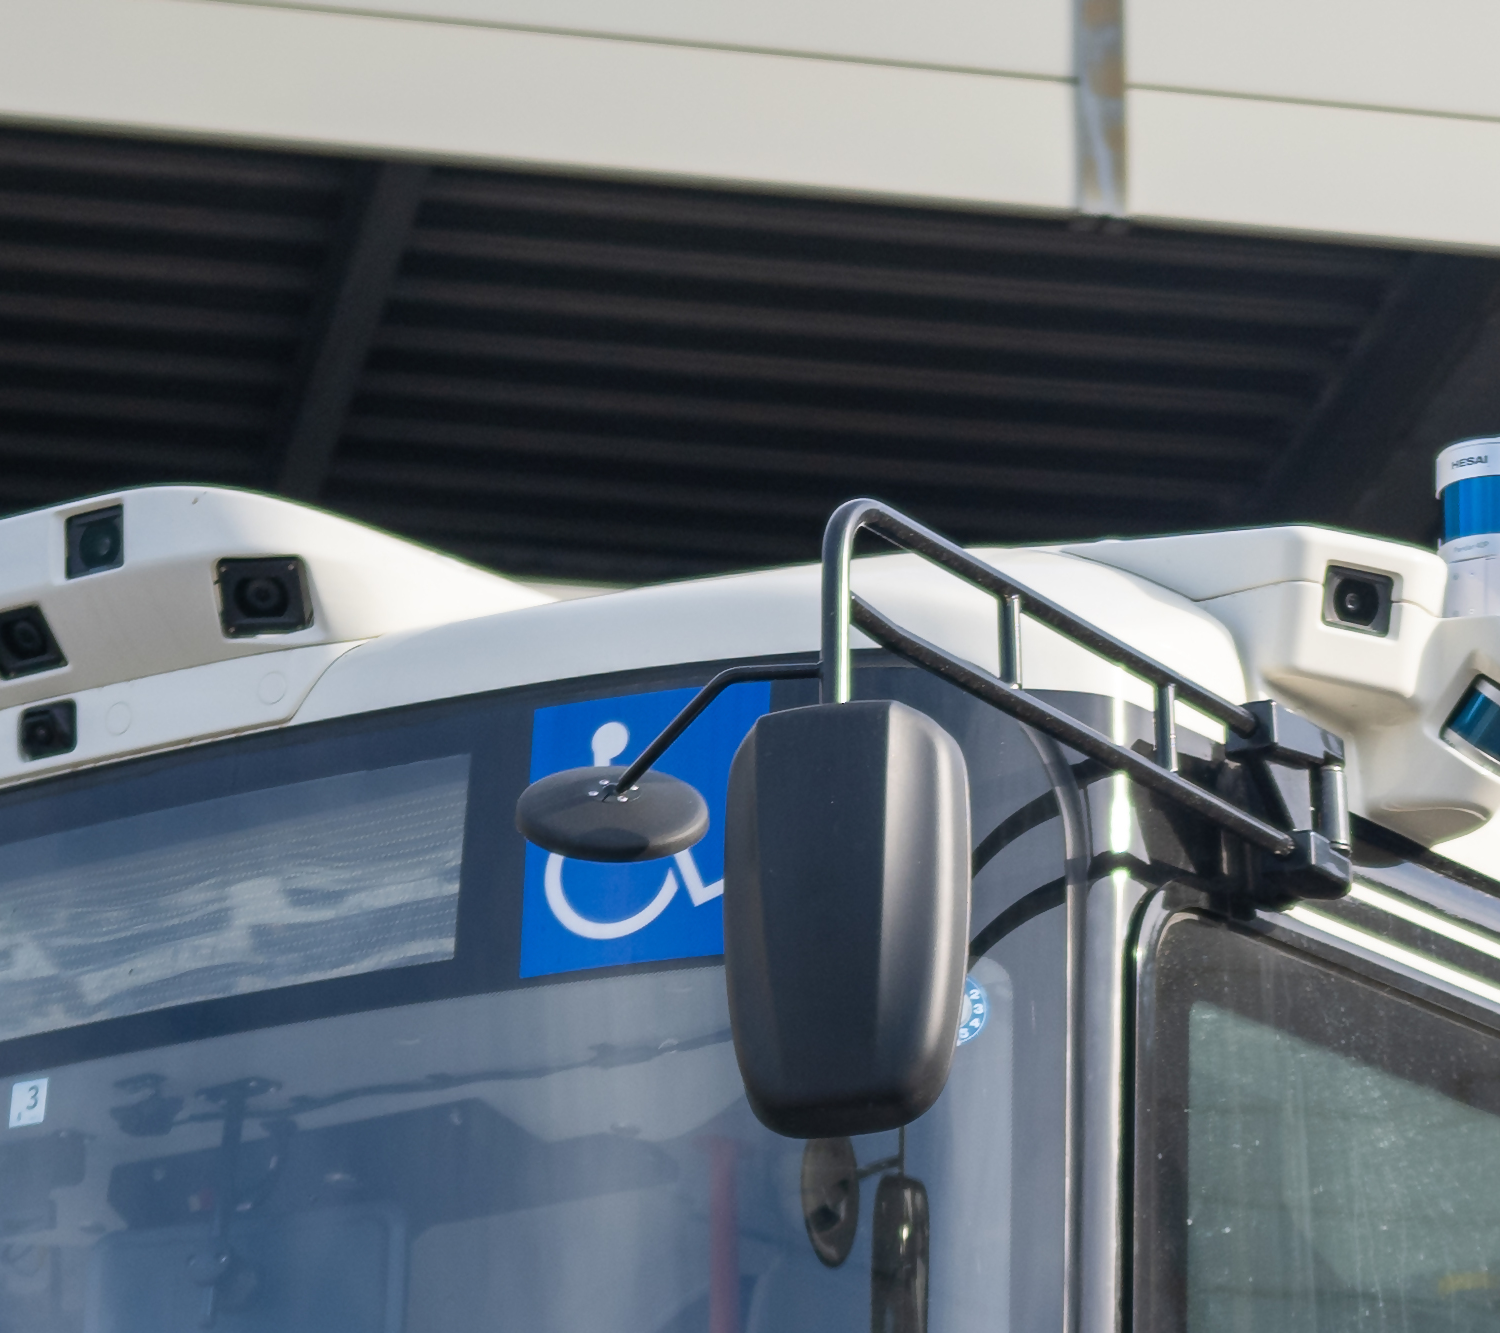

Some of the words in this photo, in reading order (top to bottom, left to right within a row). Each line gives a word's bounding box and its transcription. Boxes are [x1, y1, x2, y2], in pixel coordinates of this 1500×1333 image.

[1451, 455, 1488, 469] HESAI
[969, 988, 981, 1000] 2
[973, 1003, 984, 1015] 3
[968, 1017, 981, 1029] 4
[26, 1084, 40, 1111] 3
